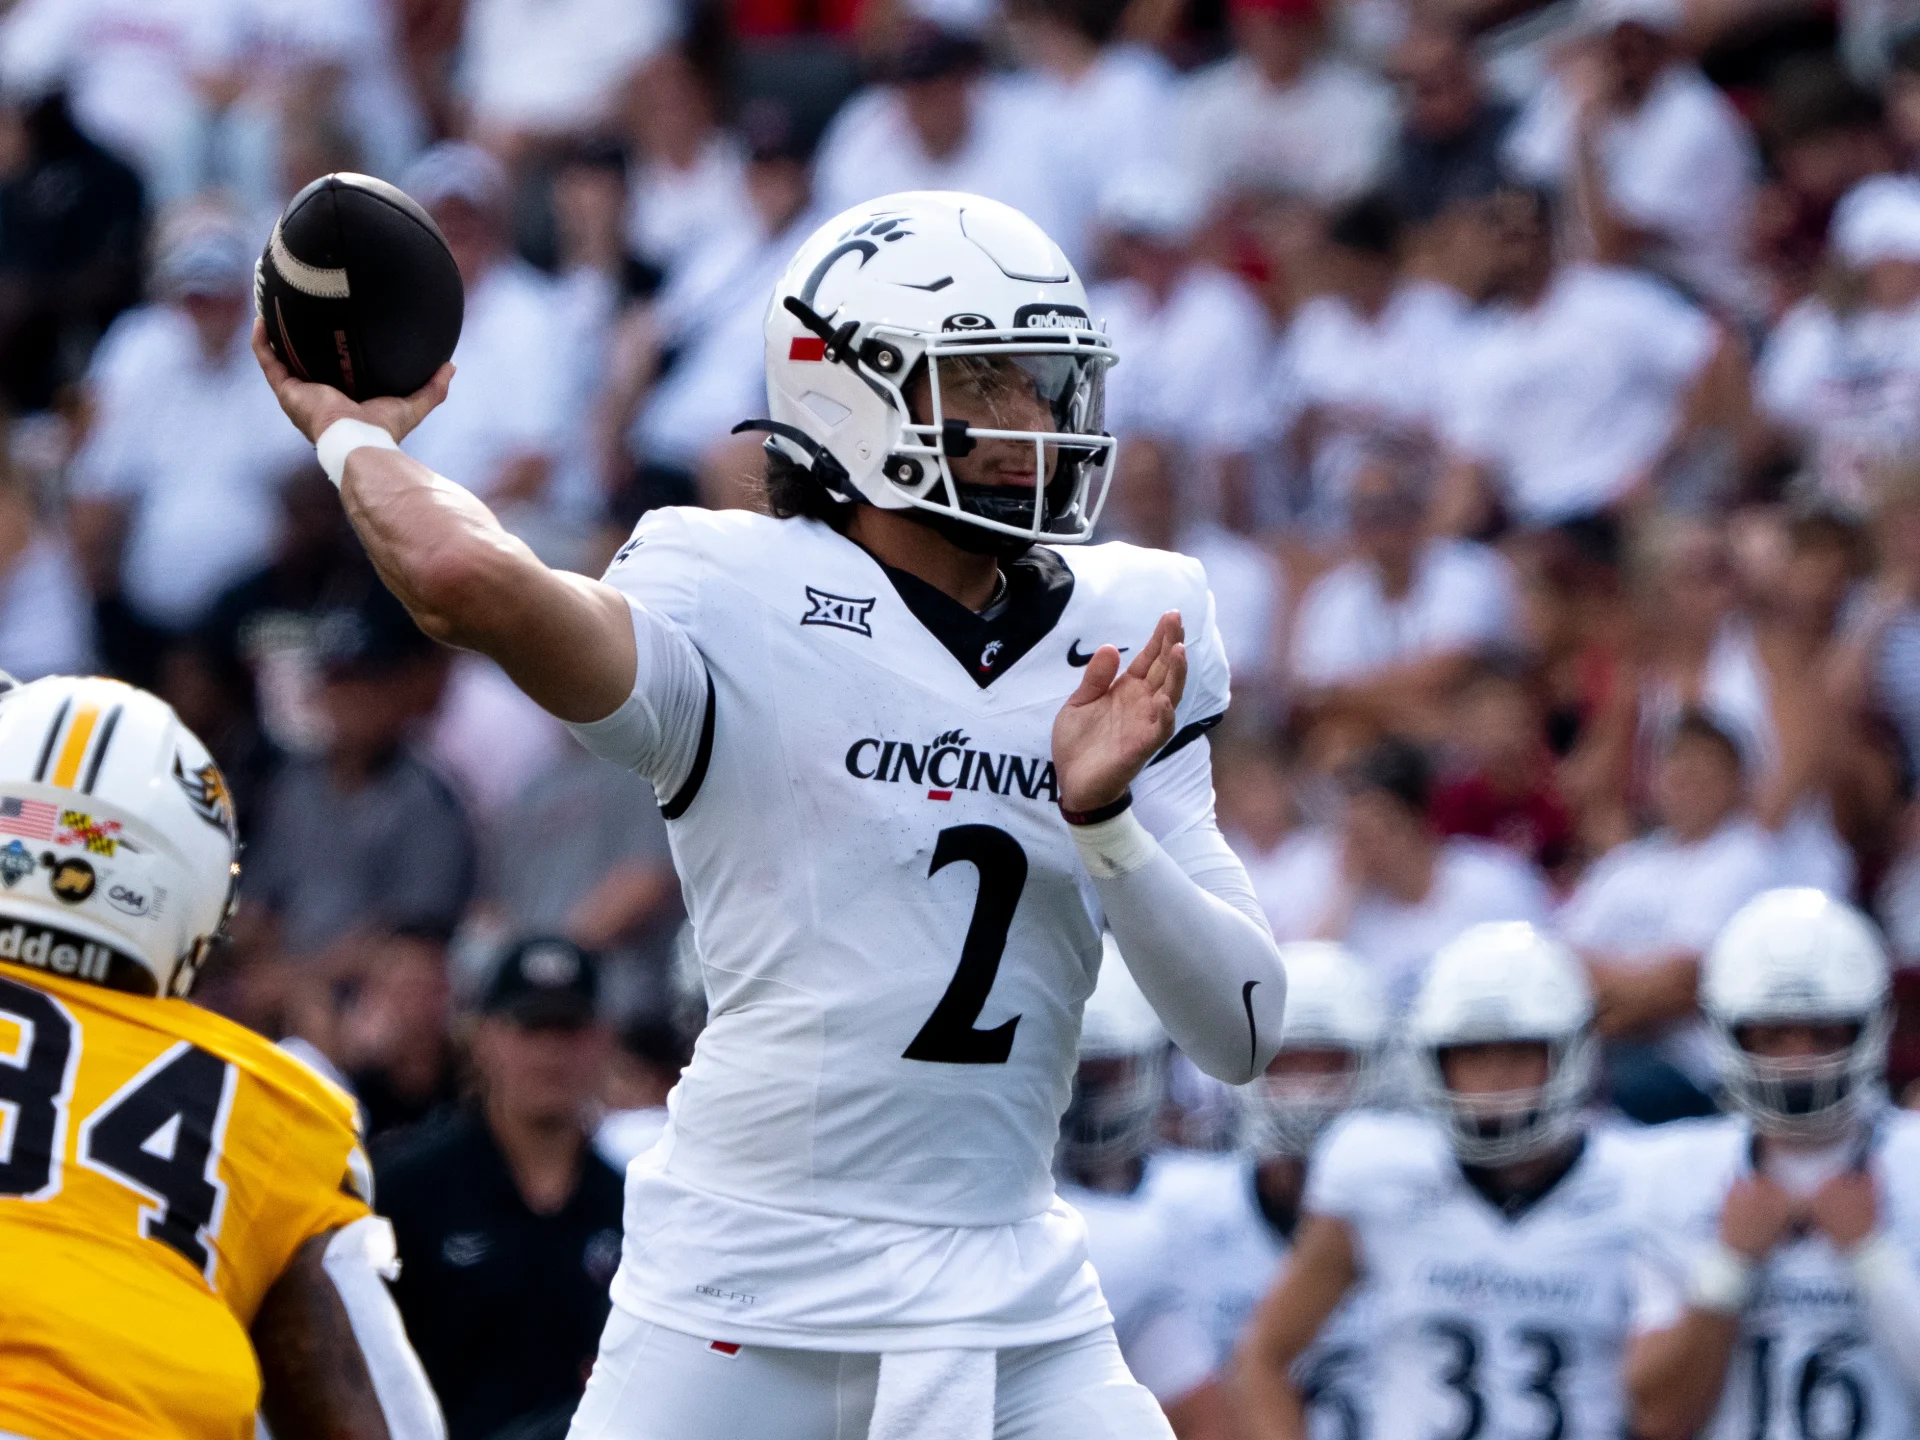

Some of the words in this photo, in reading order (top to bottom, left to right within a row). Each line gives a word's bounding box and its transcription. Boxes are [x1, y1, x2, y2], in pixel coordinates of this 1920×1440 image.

[1027, 311, 1088, 330] CINCINNATI
[901, 823, 1028, 1064] 2
[695, 1284, 757, 1304] DRI-FIT
[1416, 1314, 1572, 1440] 33
[1750, 1328, 1872, 1440] 16
